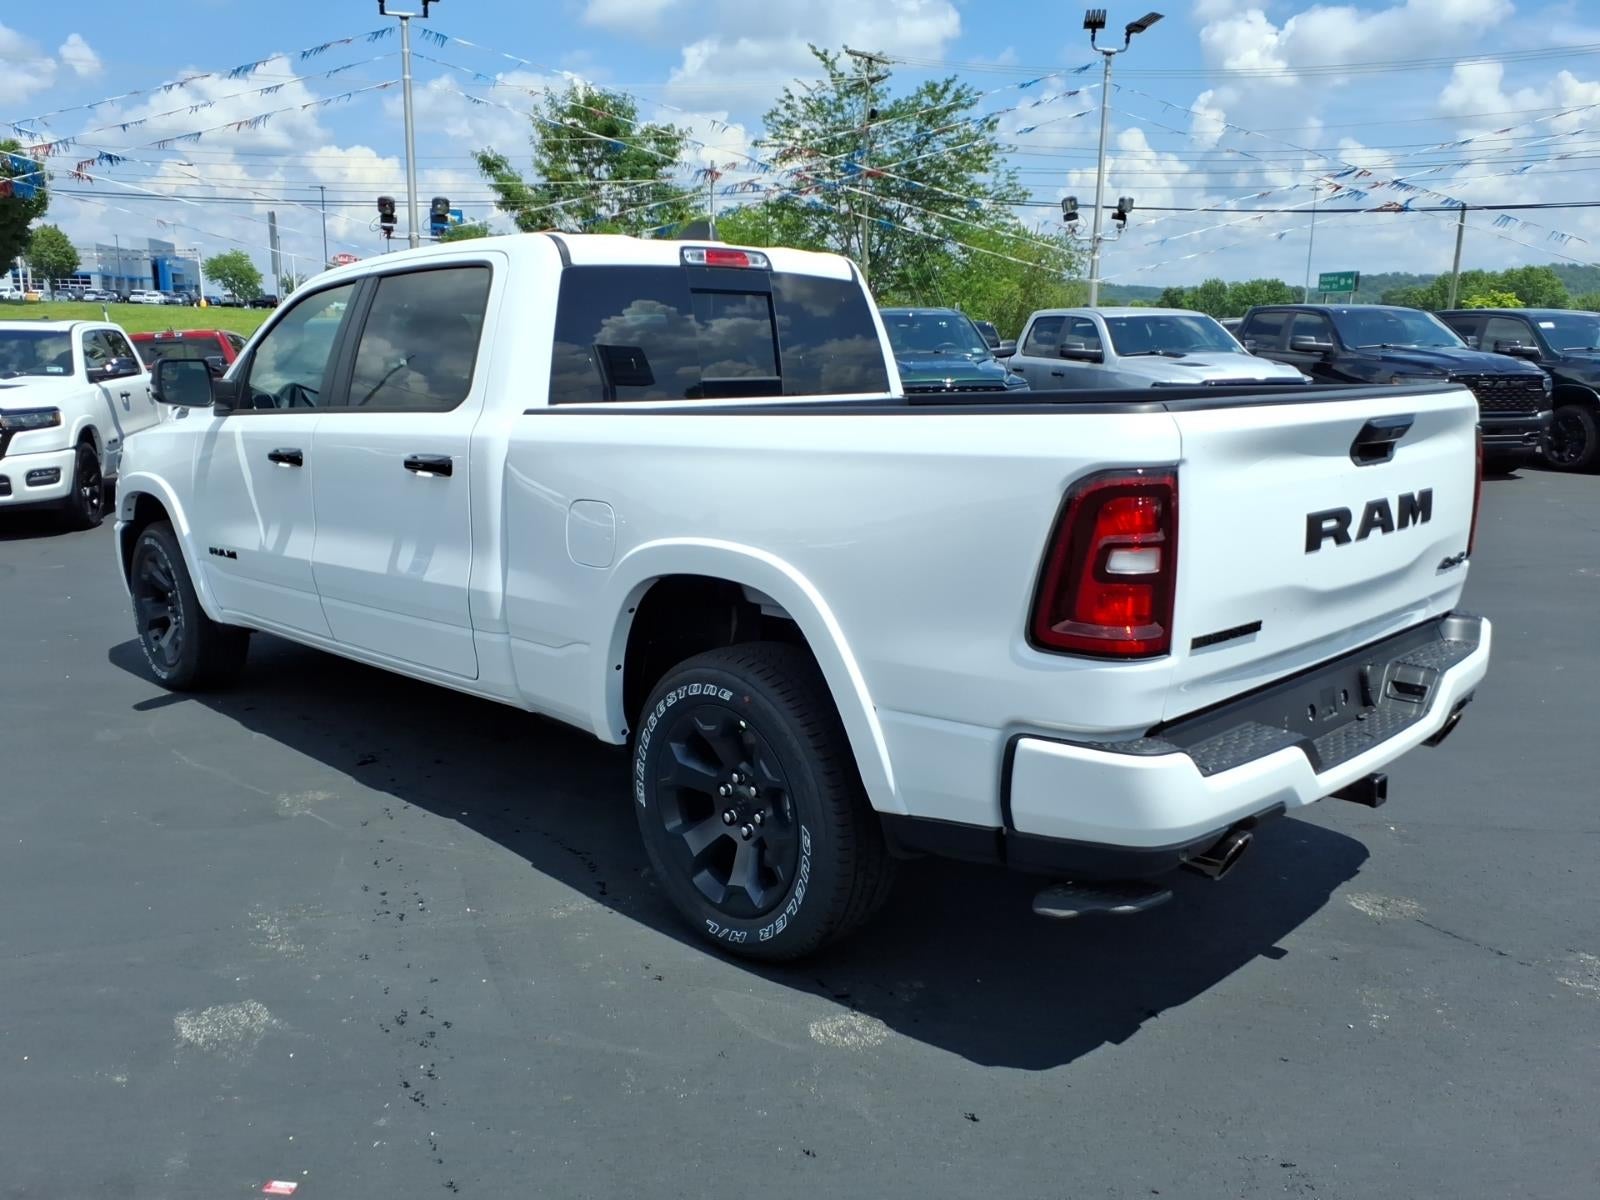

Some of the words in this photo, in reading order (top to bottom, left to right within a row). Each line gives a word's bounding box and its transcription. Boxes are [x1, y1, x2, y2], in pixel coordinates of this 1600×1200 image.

[209, 547, 238, 560] RAM
[1305, 487, 1433, 555] RAM
[635, 683, 733, 808] BRIDGESTONE
[759, 824, 812, 942] DUELER
[706, 919, 747, 943] H/L
